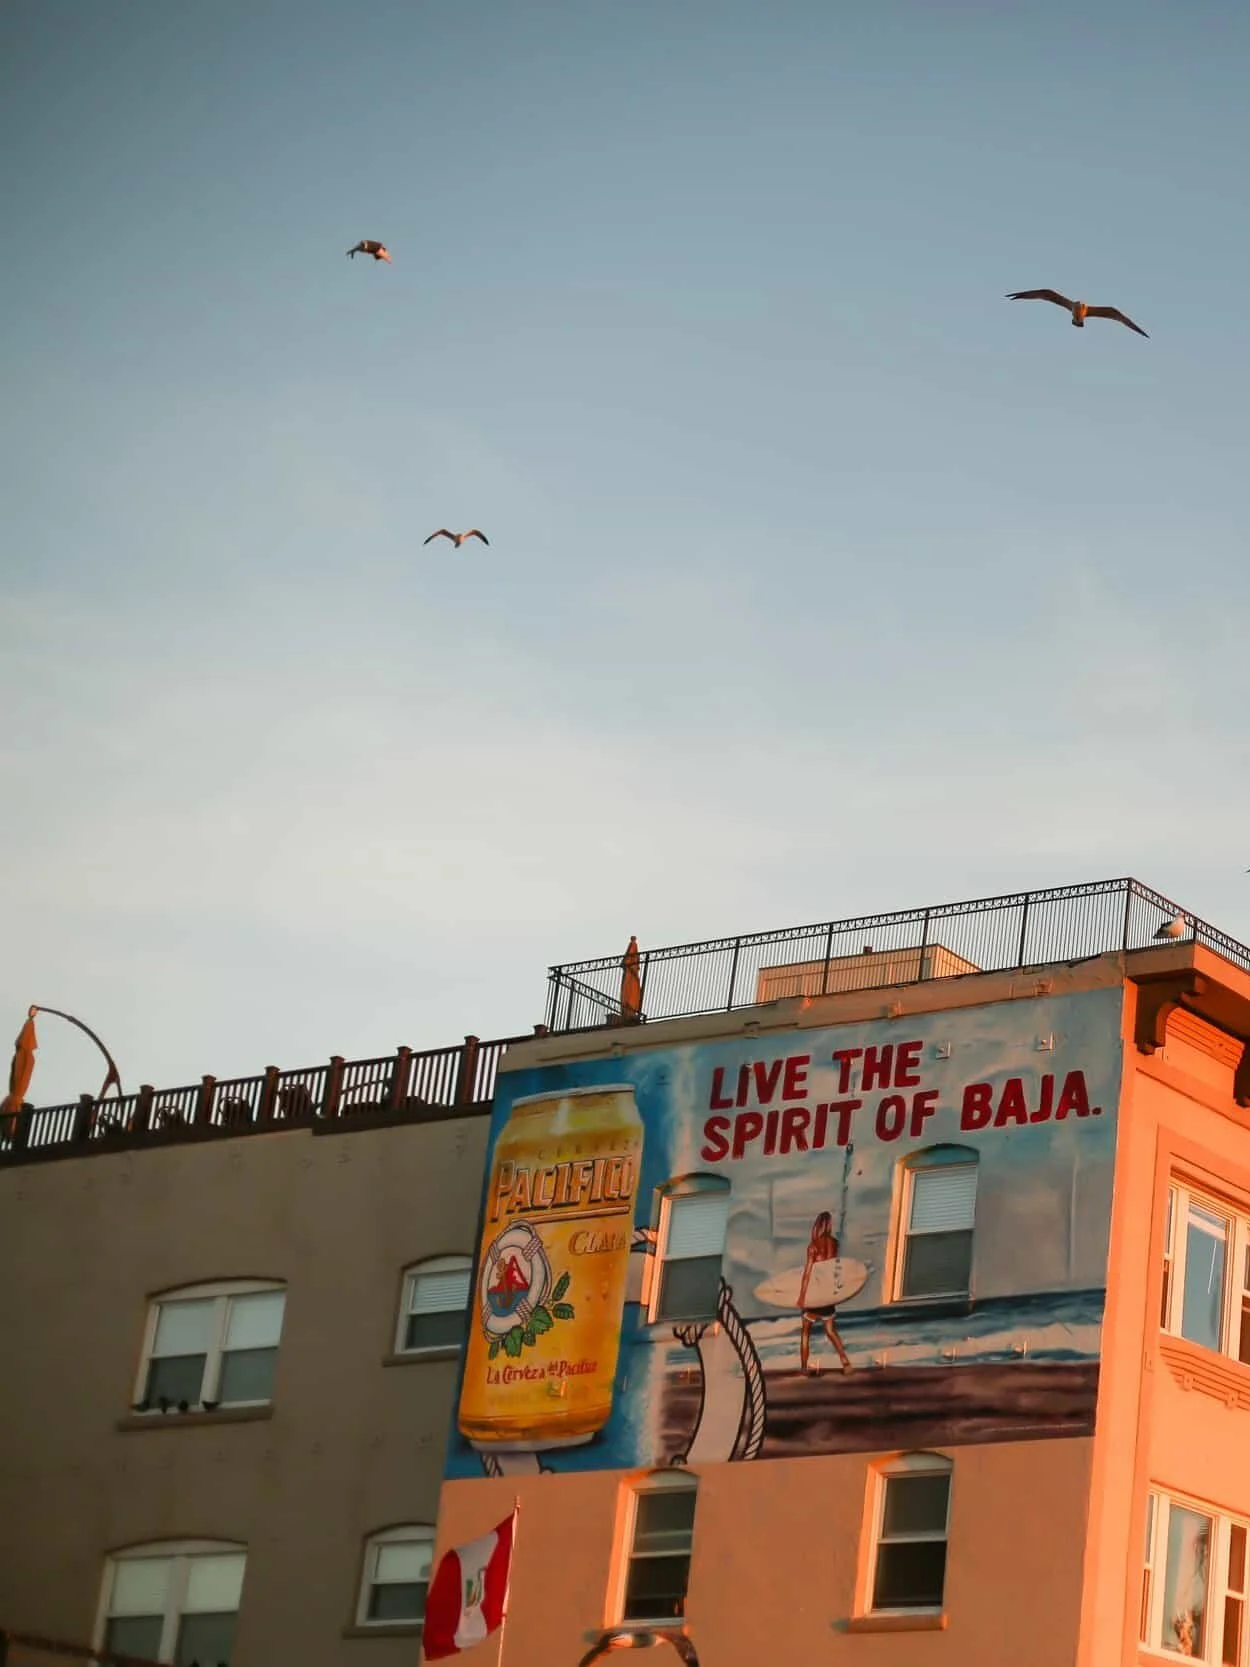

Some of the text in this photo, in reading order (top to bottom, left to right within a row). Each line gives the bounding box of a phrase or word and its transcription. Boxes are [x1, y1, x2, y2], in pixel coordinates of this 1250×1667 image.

[709, 1040, 923, 1110] LIVE THE
[700, 1070, 1102, 1162] SPIRIT OF BAJA.
[490, 1155, 634, 1223] PACIFICO
